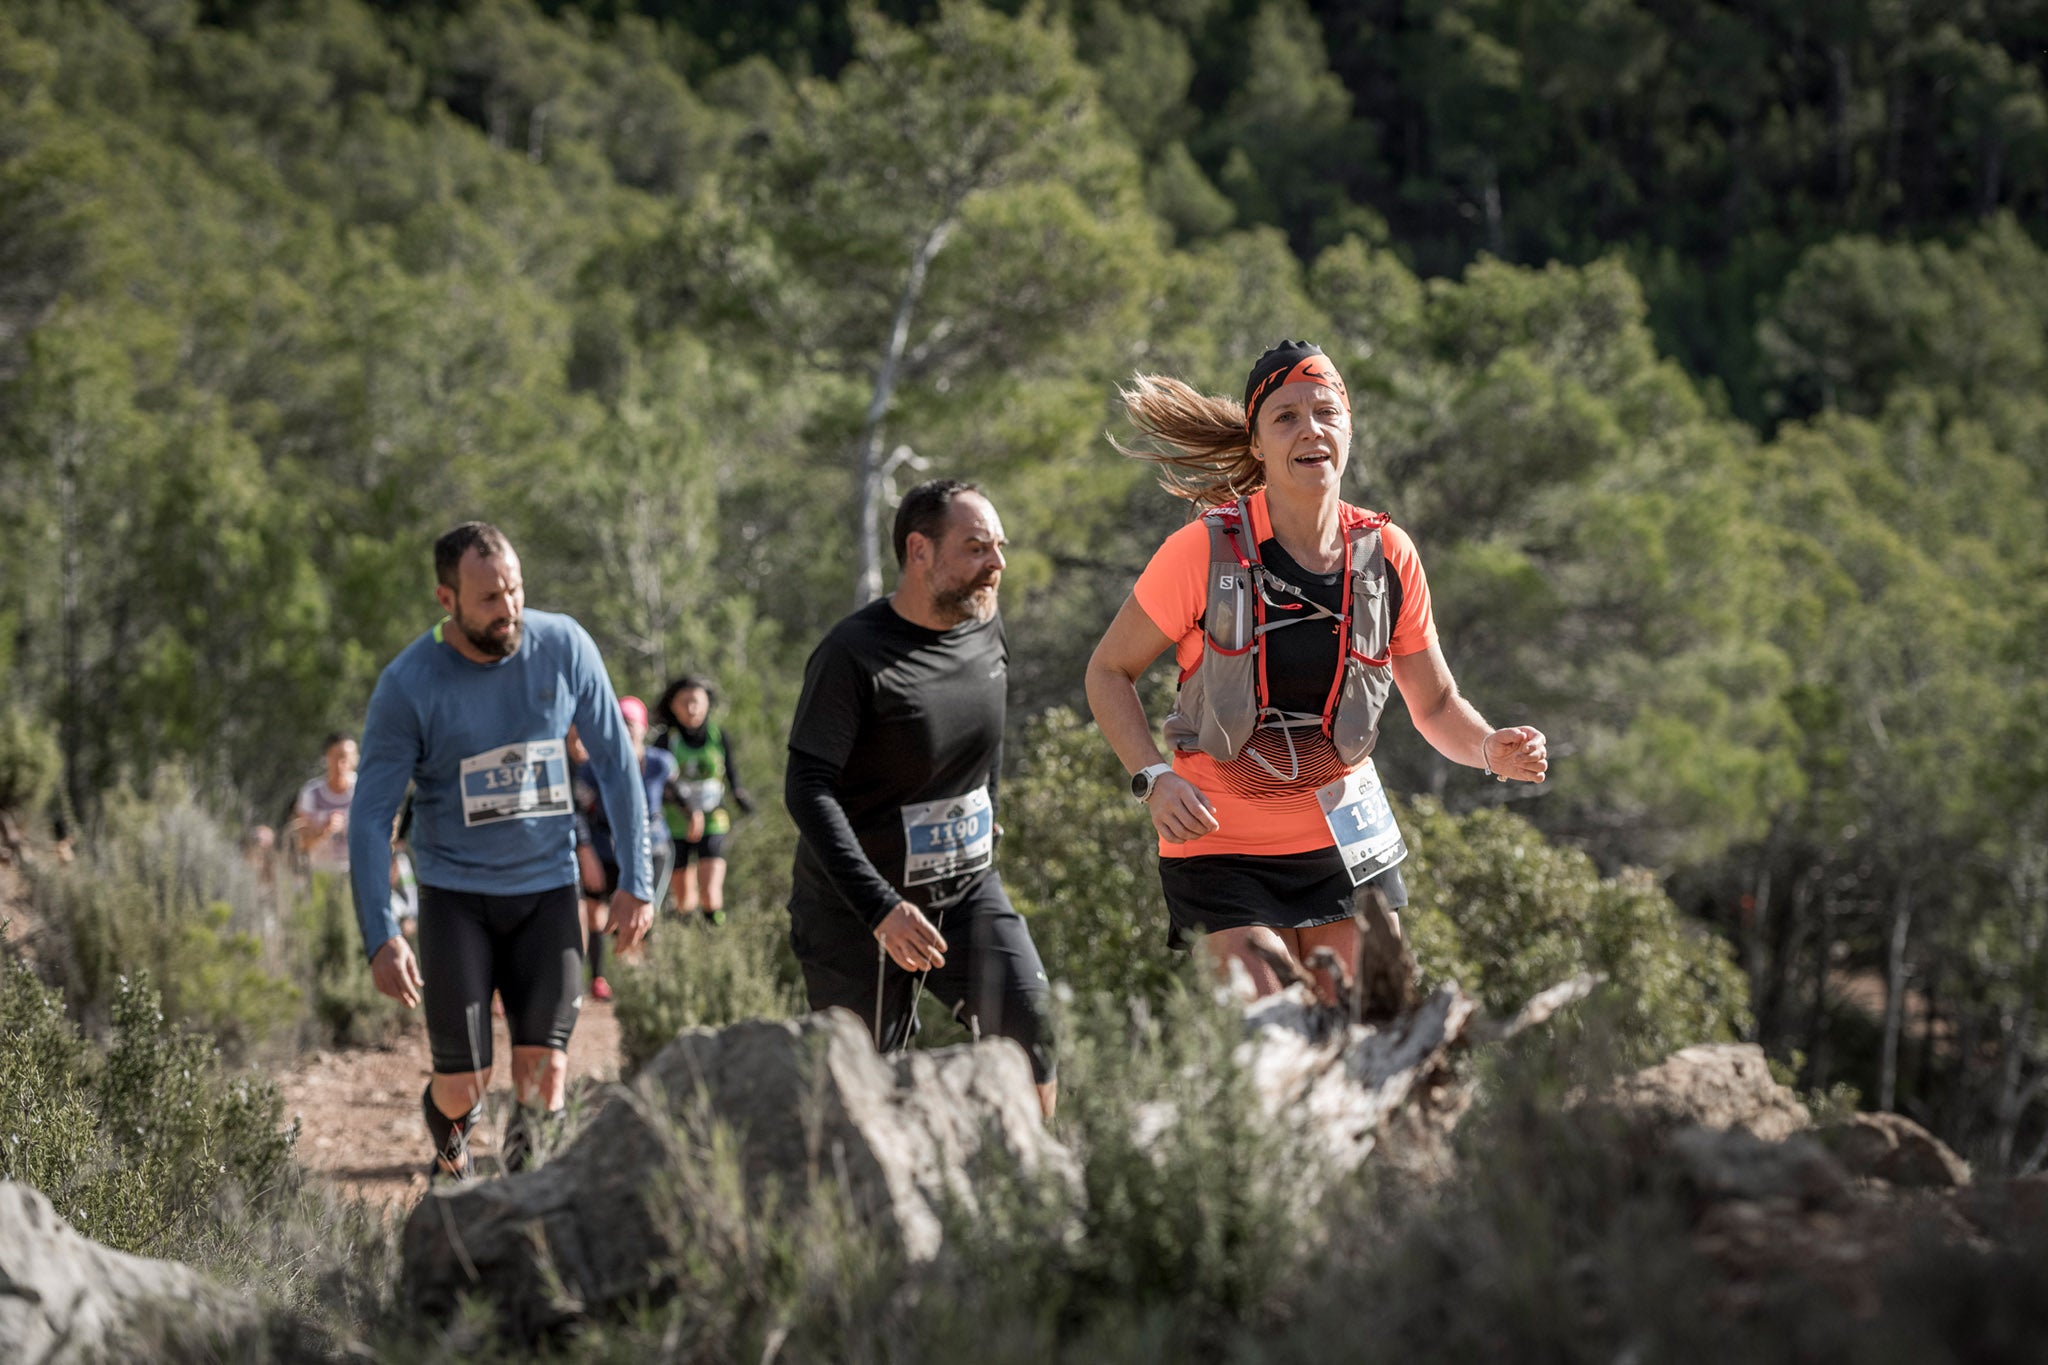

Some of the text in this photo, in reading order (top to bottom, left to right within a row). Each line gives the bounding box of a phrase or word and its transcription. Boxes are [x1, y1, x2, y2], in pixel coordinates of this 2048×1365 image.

[1221, 577, 1232, 588] S
[485, 765, 543, 789] 1307
[930, 817, 979, 845] 1190
